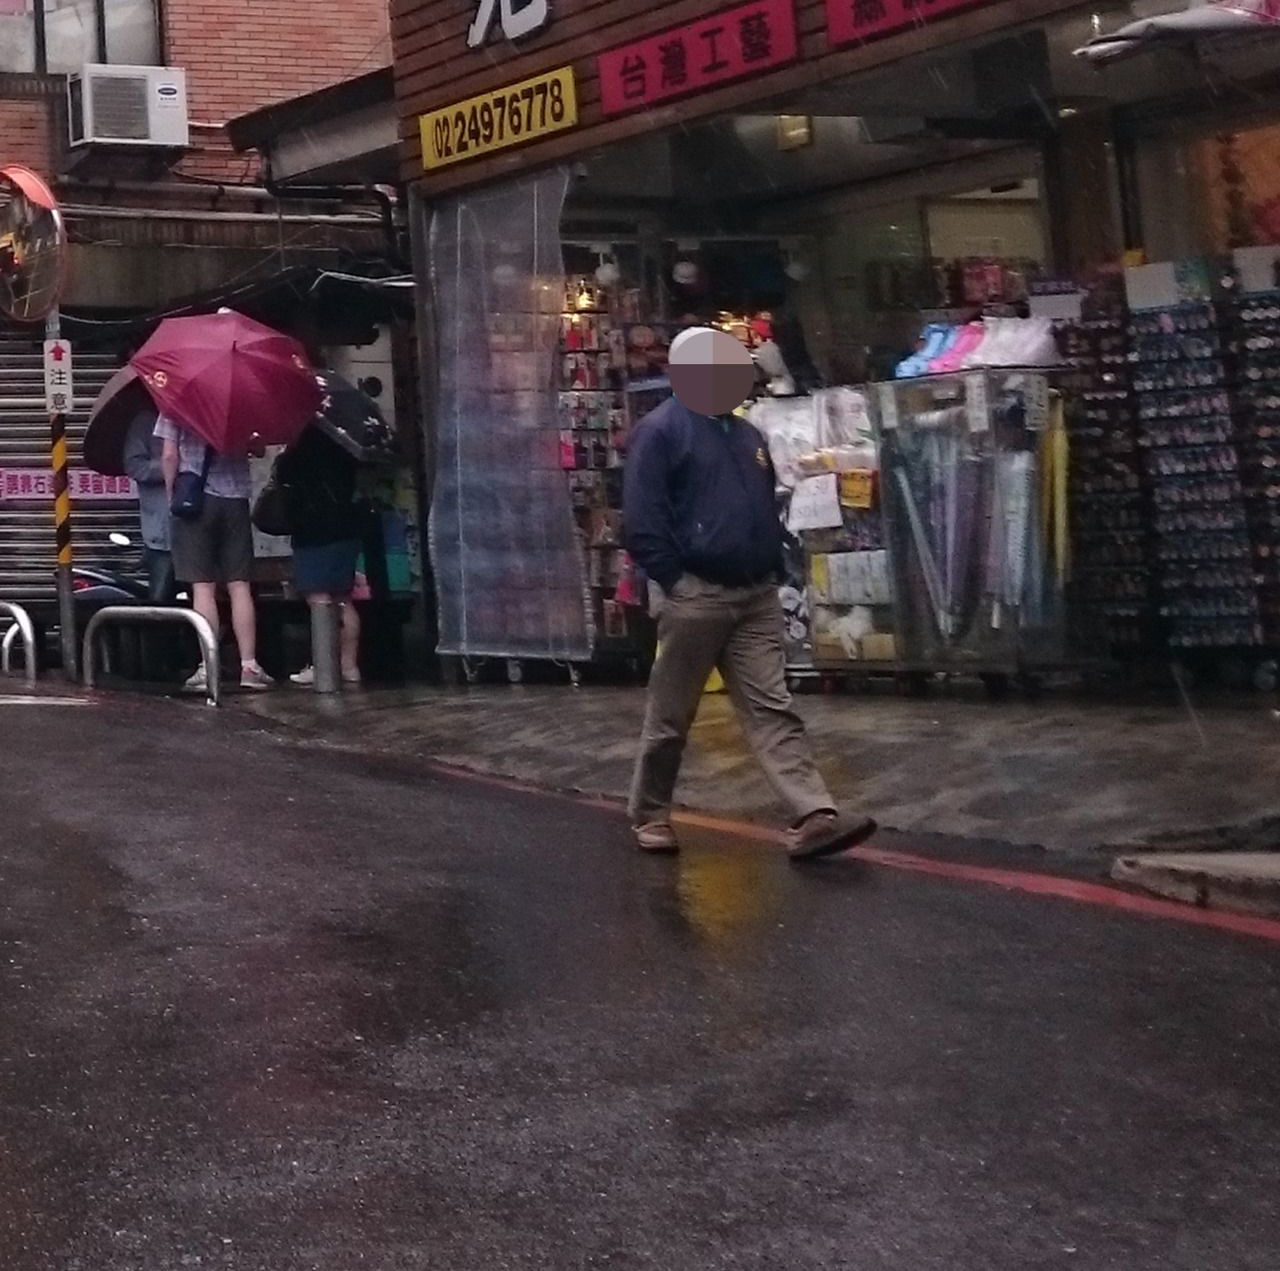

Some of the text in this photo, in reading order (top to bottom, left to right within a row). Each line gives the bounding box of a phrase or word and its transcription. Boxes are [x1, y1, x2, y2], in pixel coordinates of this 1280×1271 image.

[619, 11, 772, 101] 台灣工藝
[50, 368, 68, 410] 注意
